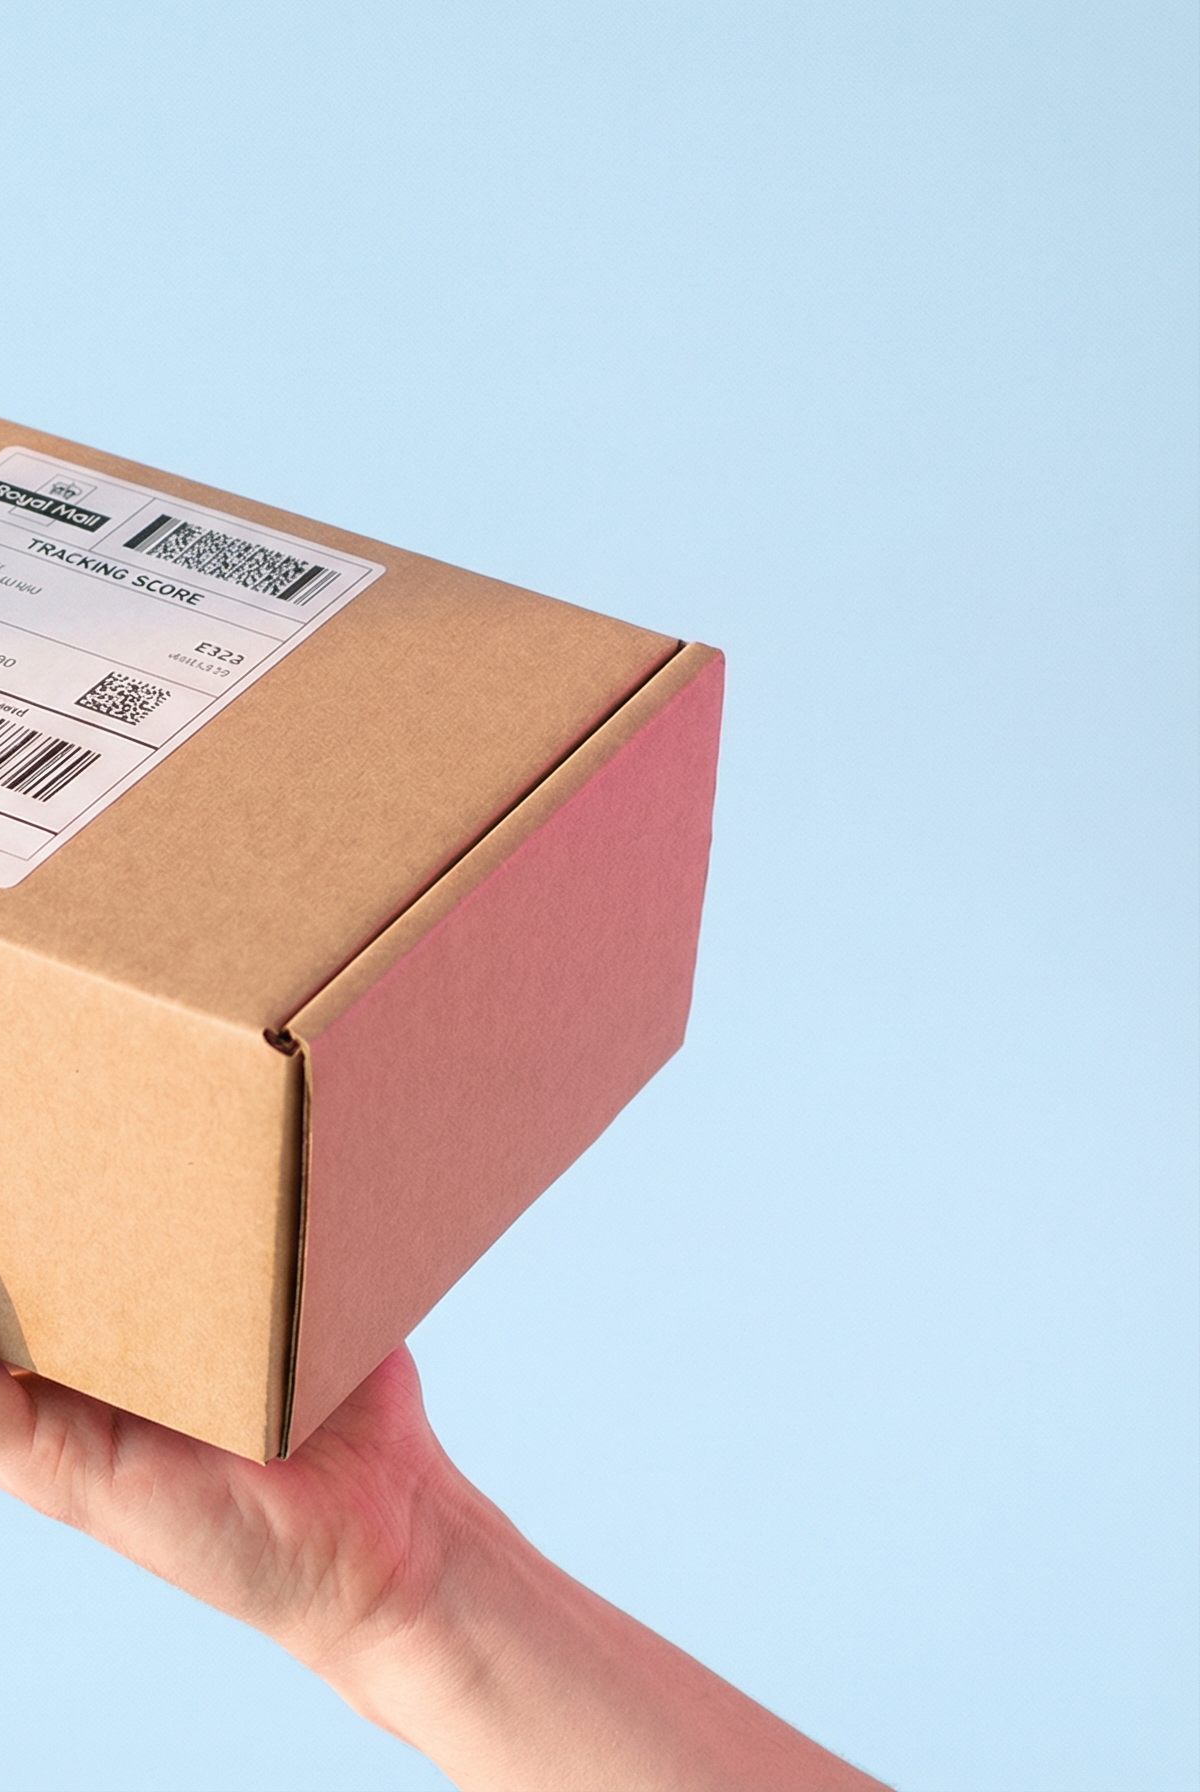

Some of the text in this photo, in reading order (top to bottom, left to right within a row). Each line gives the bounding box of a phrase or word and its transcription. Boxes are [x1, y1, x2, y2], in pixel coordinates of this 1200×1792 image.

[51, 503, 101, 527] Mail
[27, 538, 129, 580] TRACKING
[131, 574, 205, 606] SCORE
